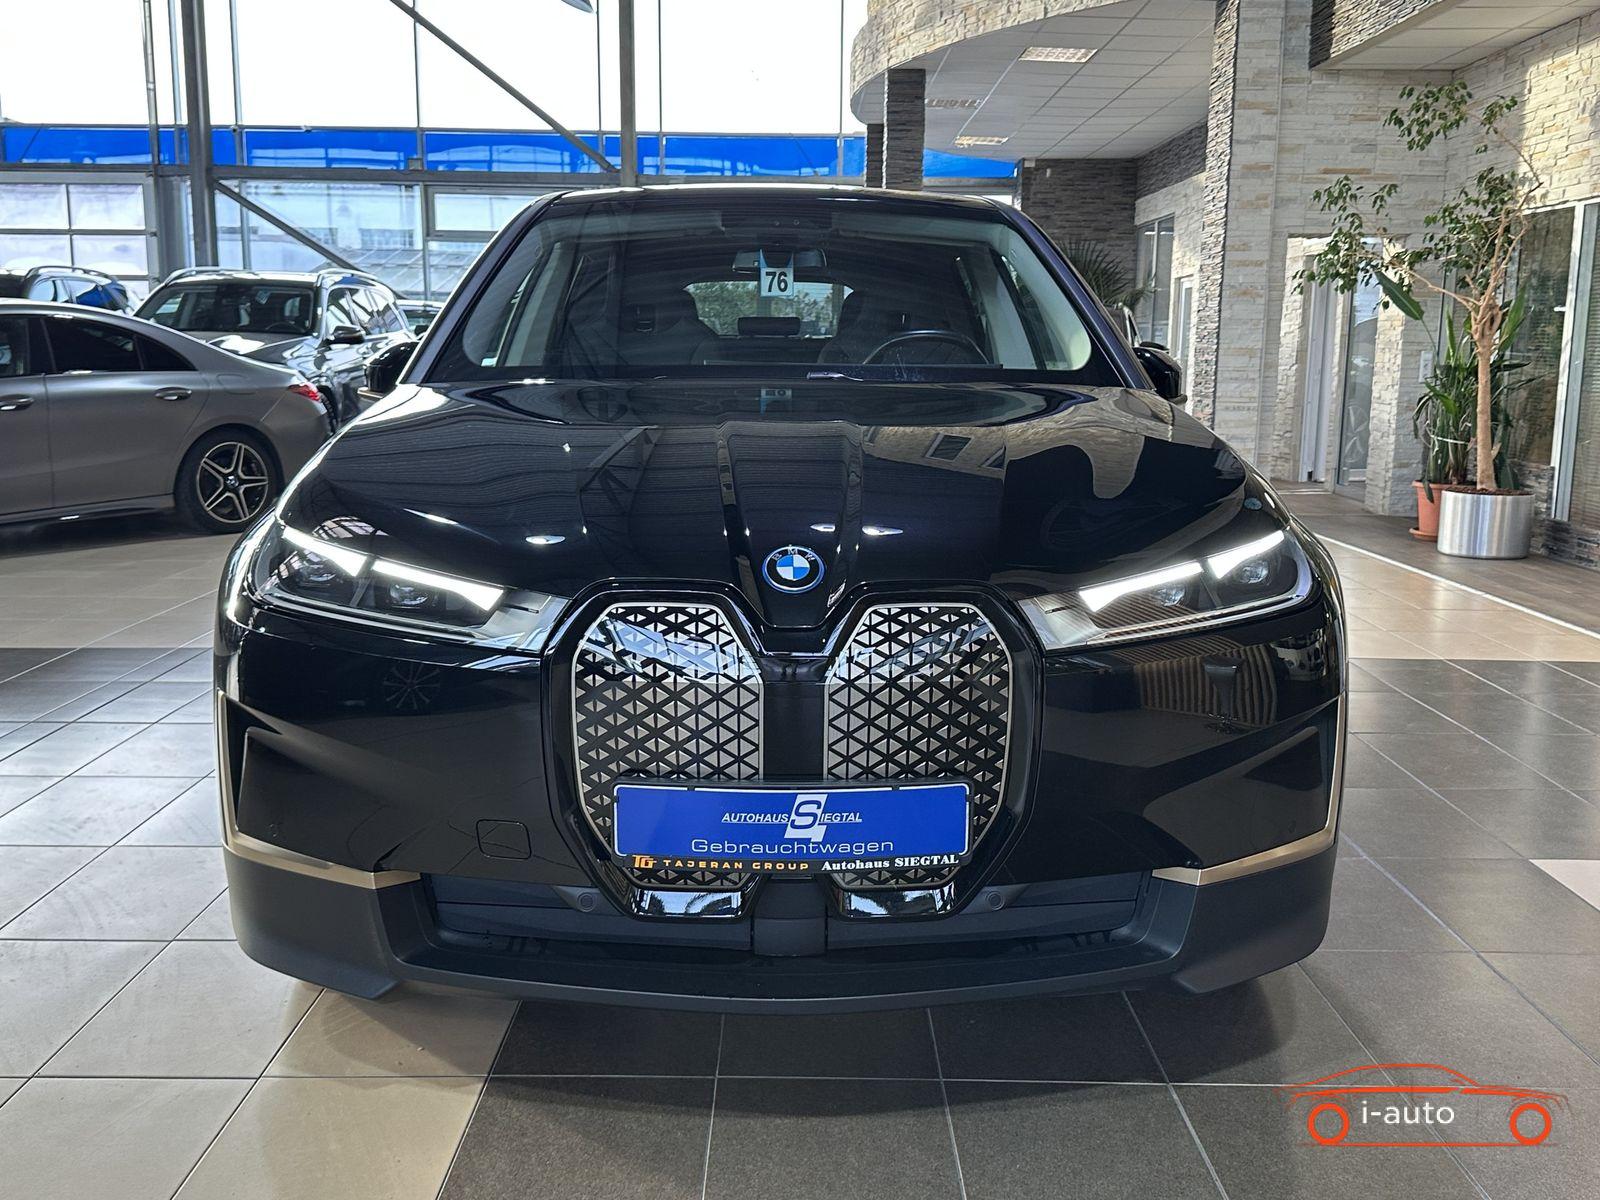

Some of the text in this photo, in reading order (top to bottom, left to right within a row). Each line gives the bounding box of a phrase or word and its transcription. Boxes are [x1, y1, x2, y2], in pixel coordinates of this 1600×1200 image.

[765, 271, 788, 293] 76
[771, 546, 816, 562] BMW
[721, 812, 789, 823] AUTOHAUS
[691, 839, 894, 855] Gebrauchtwagen
[663, 859, 743, 869] TAJERAN
[752, 862, 809, 870] GROUP
[821, 857, 890, 871] Autohaus
[894, 854, 959, 868] SIEGTAL
